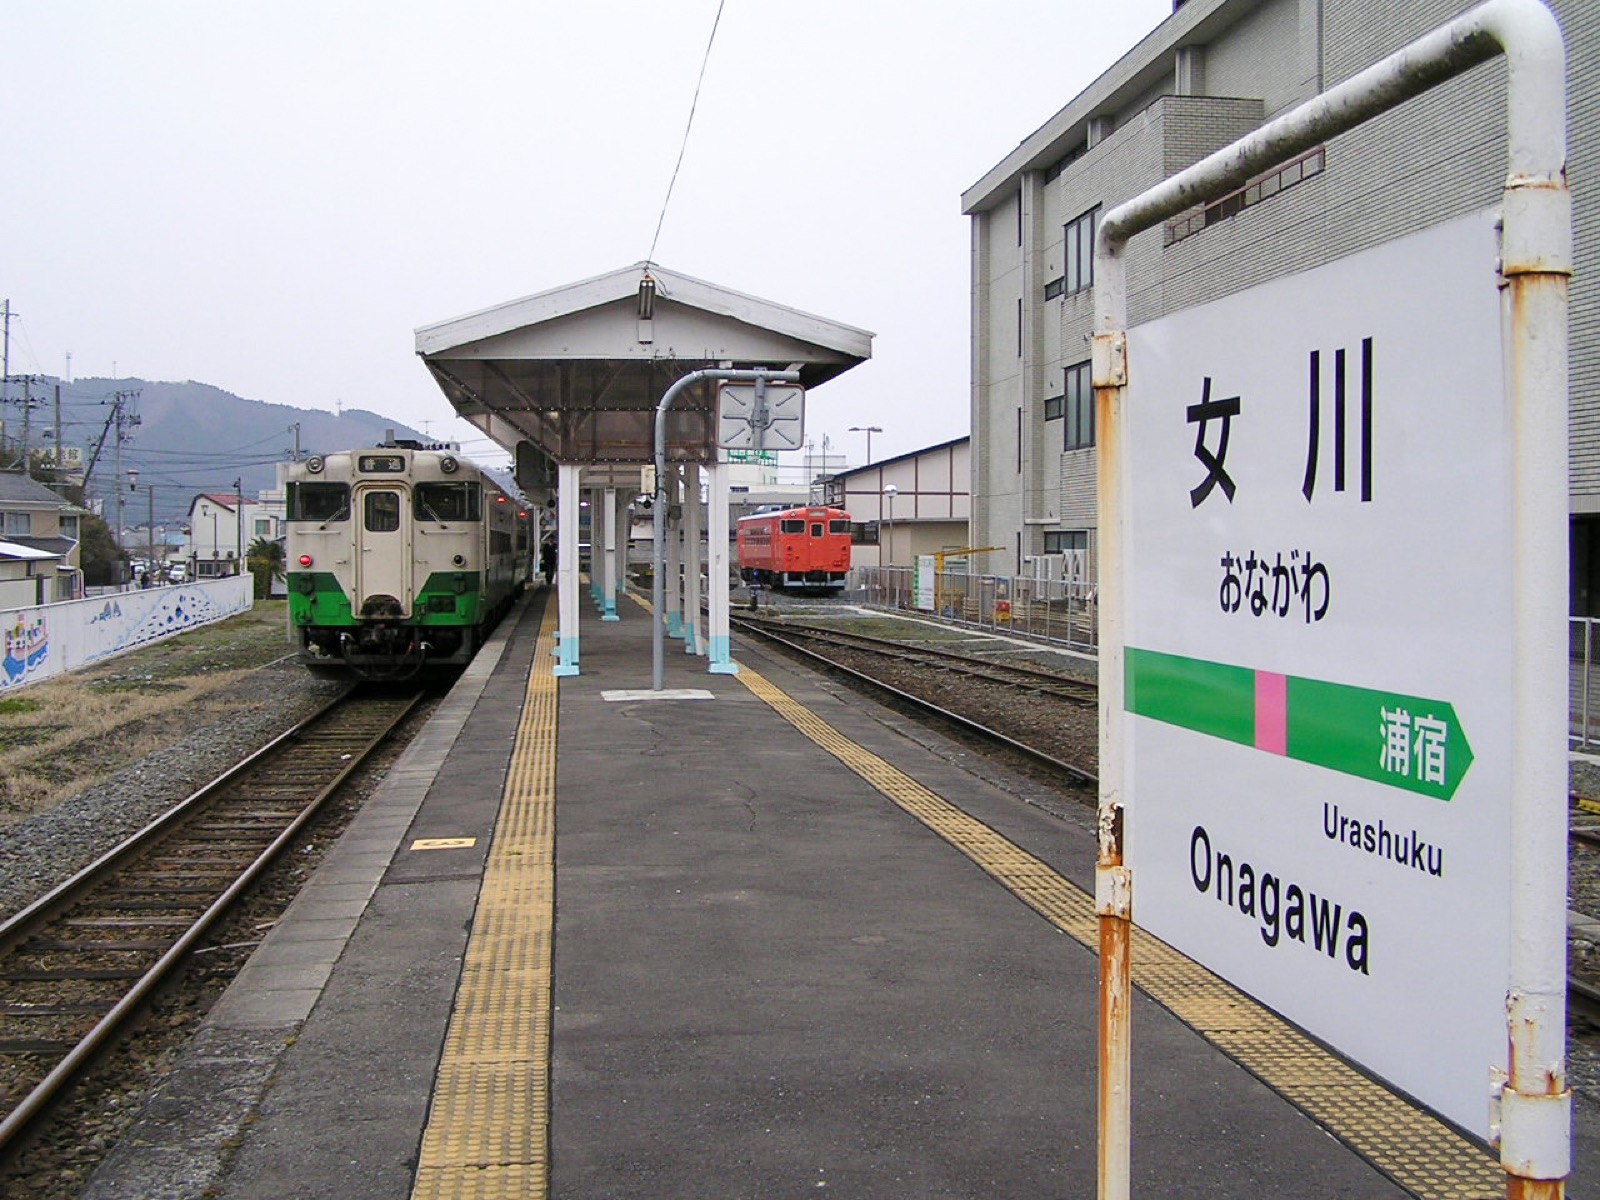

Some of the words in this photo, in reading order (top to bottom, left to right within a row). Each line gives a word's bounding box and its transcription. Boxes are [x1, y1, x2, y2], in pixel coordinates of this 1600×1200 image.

[1186, 336, 1373, 509] 女川
[1219, 549, 1331, 625] おながわ
[1379, 705, 1447, 786] 浦宿
[1325, 802, 1443, 877] Urashuku
[1191, 825, 1368, 976] Onagawa
